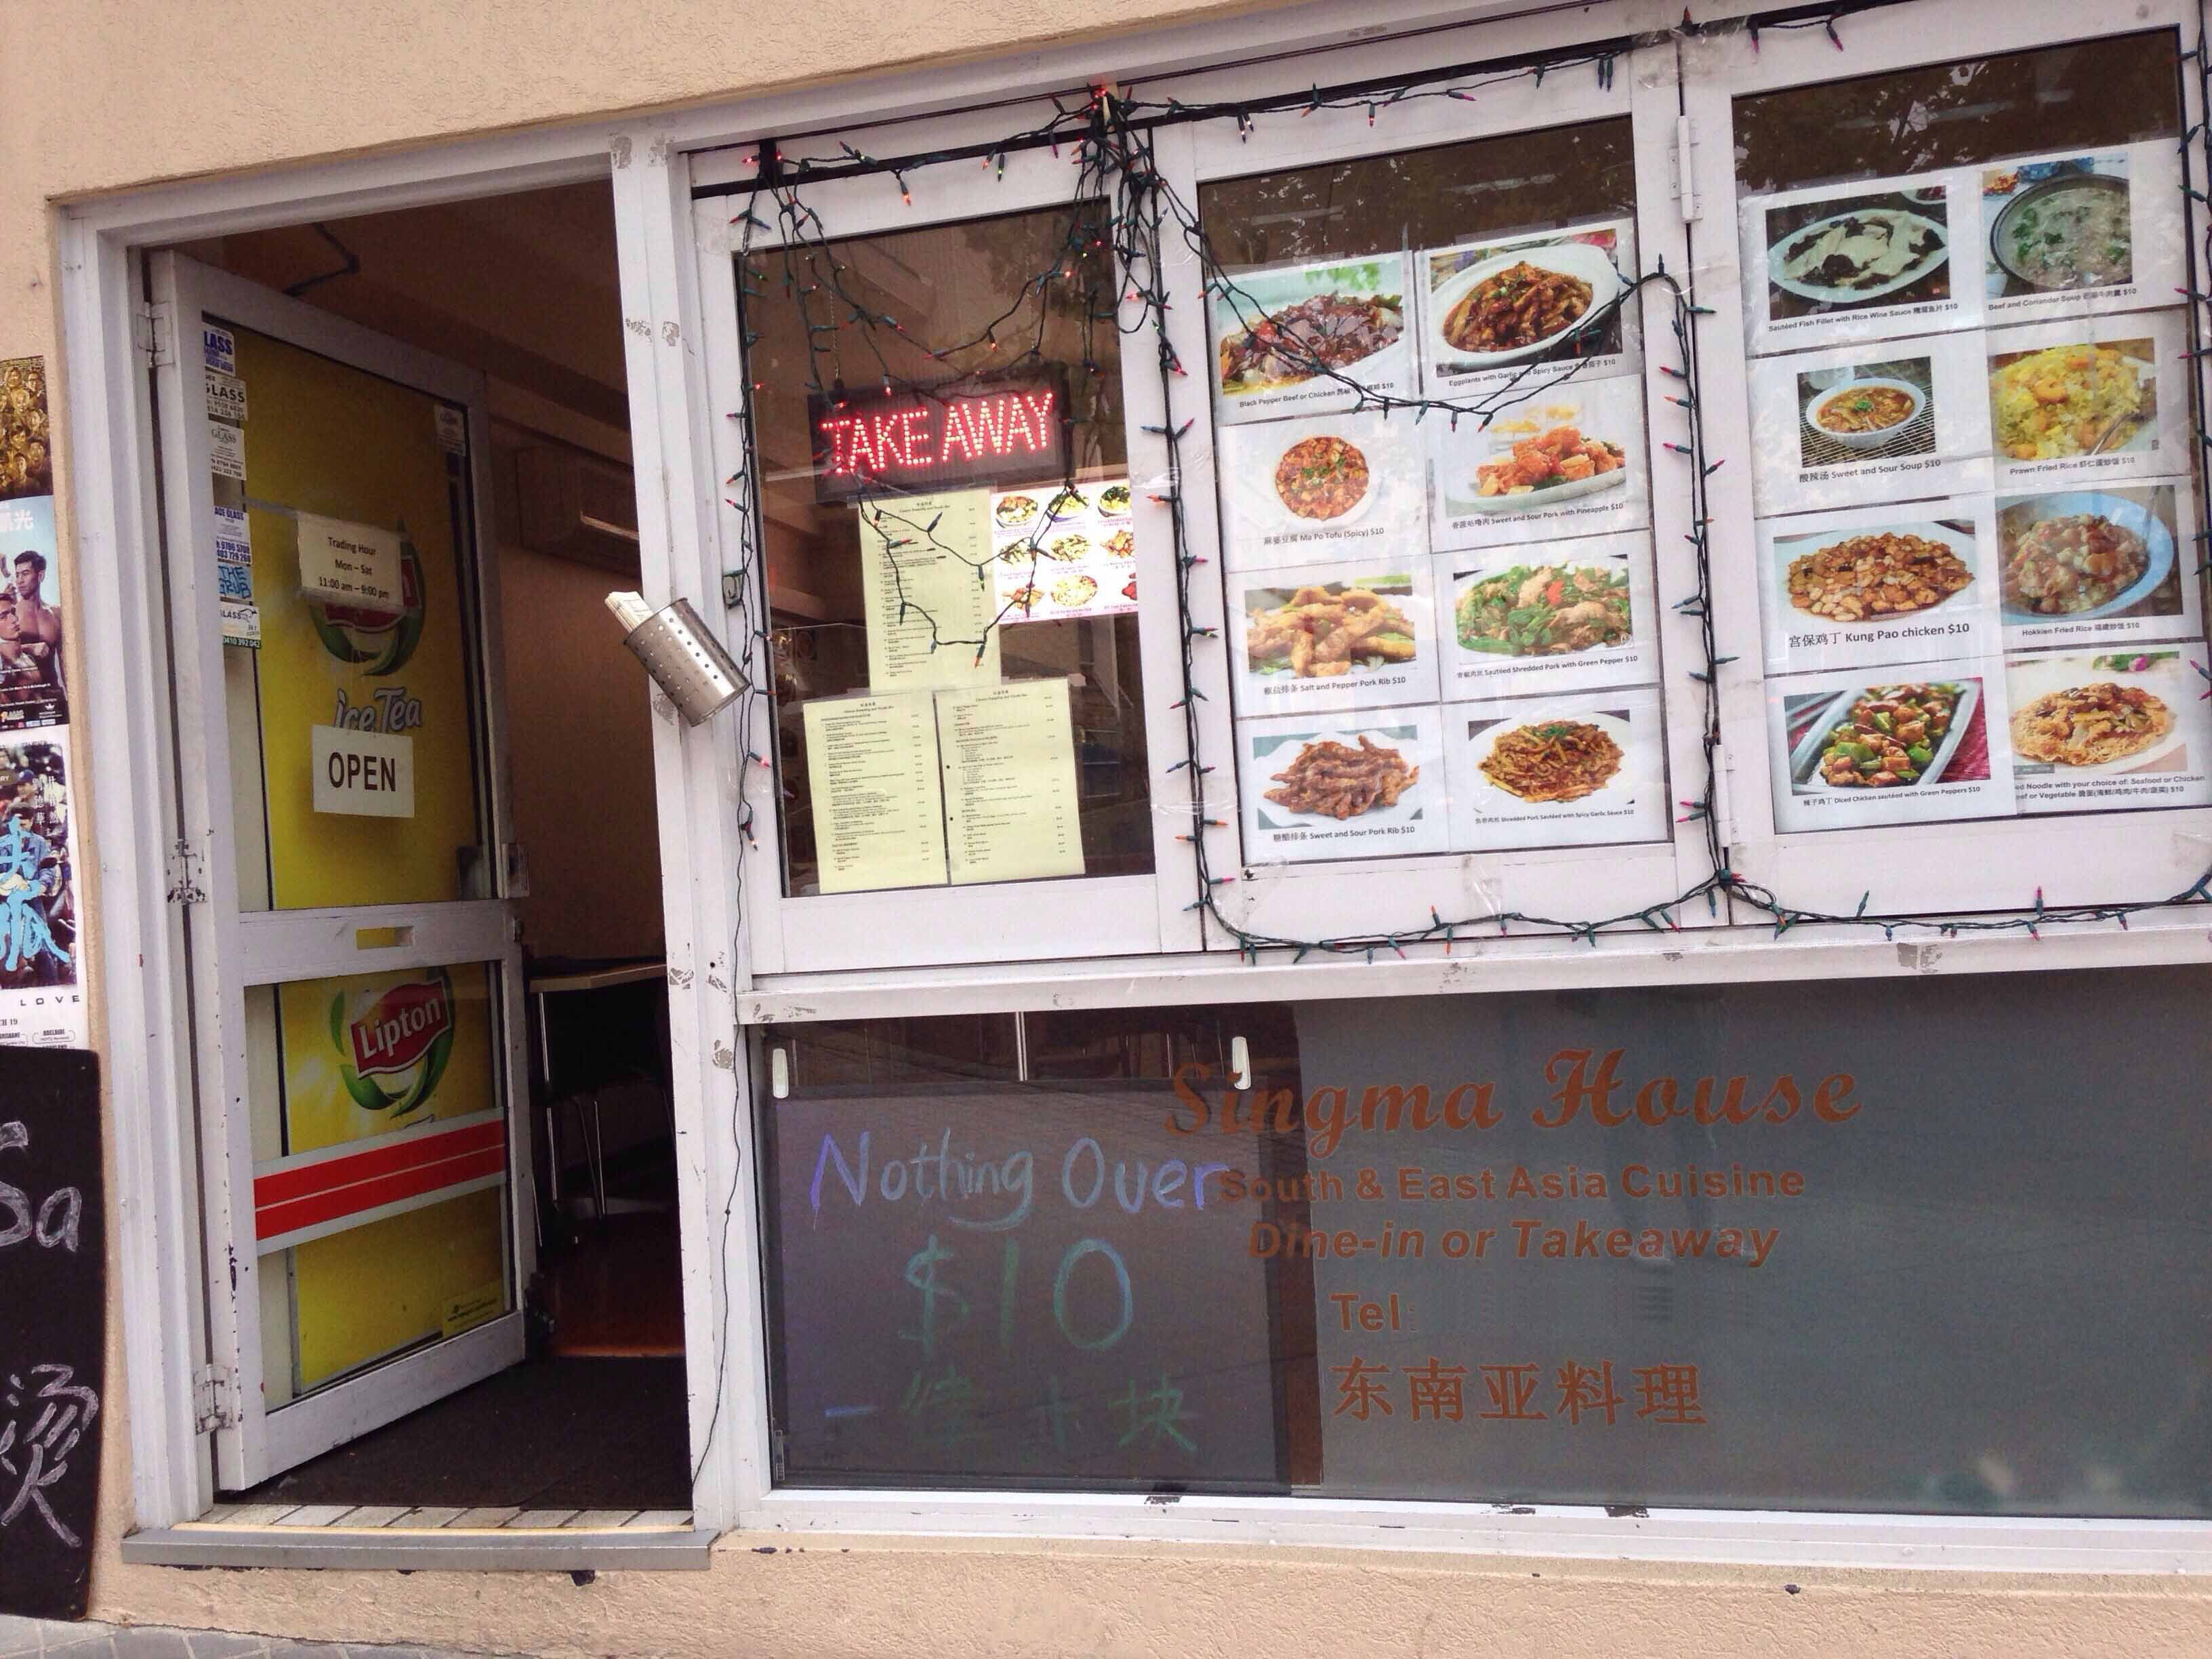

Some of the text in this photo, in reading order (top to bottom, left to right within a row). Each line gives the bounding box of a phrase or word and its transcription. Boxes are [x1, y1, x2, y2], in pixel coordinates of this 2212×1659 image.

[1988, 302, 2005, 311] Beef
[2022, 297, 2060, 306] Coriander
[2061, 294, 2081, 303] Soup
[1835, 314, 1851, 323] with
[1889, 309, 1911, 317] Sauce
[1449, 377, 1481, 386] Eggplants
[1532, 366, 1551, 375] Spicy
[1553, 363, 1573, 371] Sauce
[1258, 396, 1281, 405] Pepper
[1284, 394, 1298, 402] Beef
[1309, 390, 1335, 398] Chicken
[819, 392, 1055, 474] TAKE AWAY
[1831, 469, 1858, 478] Sweet
[1861, 467, 1876, 475] and
[1900, 462, 1922, 472] Soup
[1924, 459, 1941, 468] $10
[2010, 467, 2034, 475] Prawn
[2037, 464, 2058, 472] Fried
[1492, 516, 1512, 525] Sweet
[1576, 505, 1608, 516] Pineapple
[1344, 529, 1369, 539] (Spicy)
[328, 536, 376, 555] Trading Hour
[218, 565, 245, 580] THE
[335, 559, 352, 571] Mon
[361, 565, 373, 575] Sat
[319, 577, 339, 589] 11:00
[341, 583, 352, 592] am
[378, 590, 389, 599] pm
[1789, 623, 1969, 648] 宫保鸡丁 Kung Pao chicken $10
[1513, 664, 1543, 673] Shredded
[1600, 657, 1623, 665] Pepper
[1332, 680, 1357, 690] Pepper
[374, 687, 423, 734] Tea
[329, 752, 396, 792] OPEN
[2131, 777, 2162, 785] Seafood
[1852, 794, 1877, 802] Chicken
[1941, 787, 1967, 796] Peppers
[2039, 791, 2076, 799] Vegetable
[1501, 815, 1525, 823] Shredded
[1310, 832, 1332, 840] Sweet
[20, 995, 80, 1006] LOVE
[356, 994, 442, 1059] Lipton
[1164, 1048, 1862, 1159] Singma House
[811, 1127, 1230, 1231] Nothing Over
[1220, 1162, 1805, 1204] South & East Asia Cuisine
[1248, 1220, 1780, 1269] Dine-in or Takeaway
[899, 1235, 1133, 1355] $10
[1331, 1355, 1708, 1426] 东南亚料理
